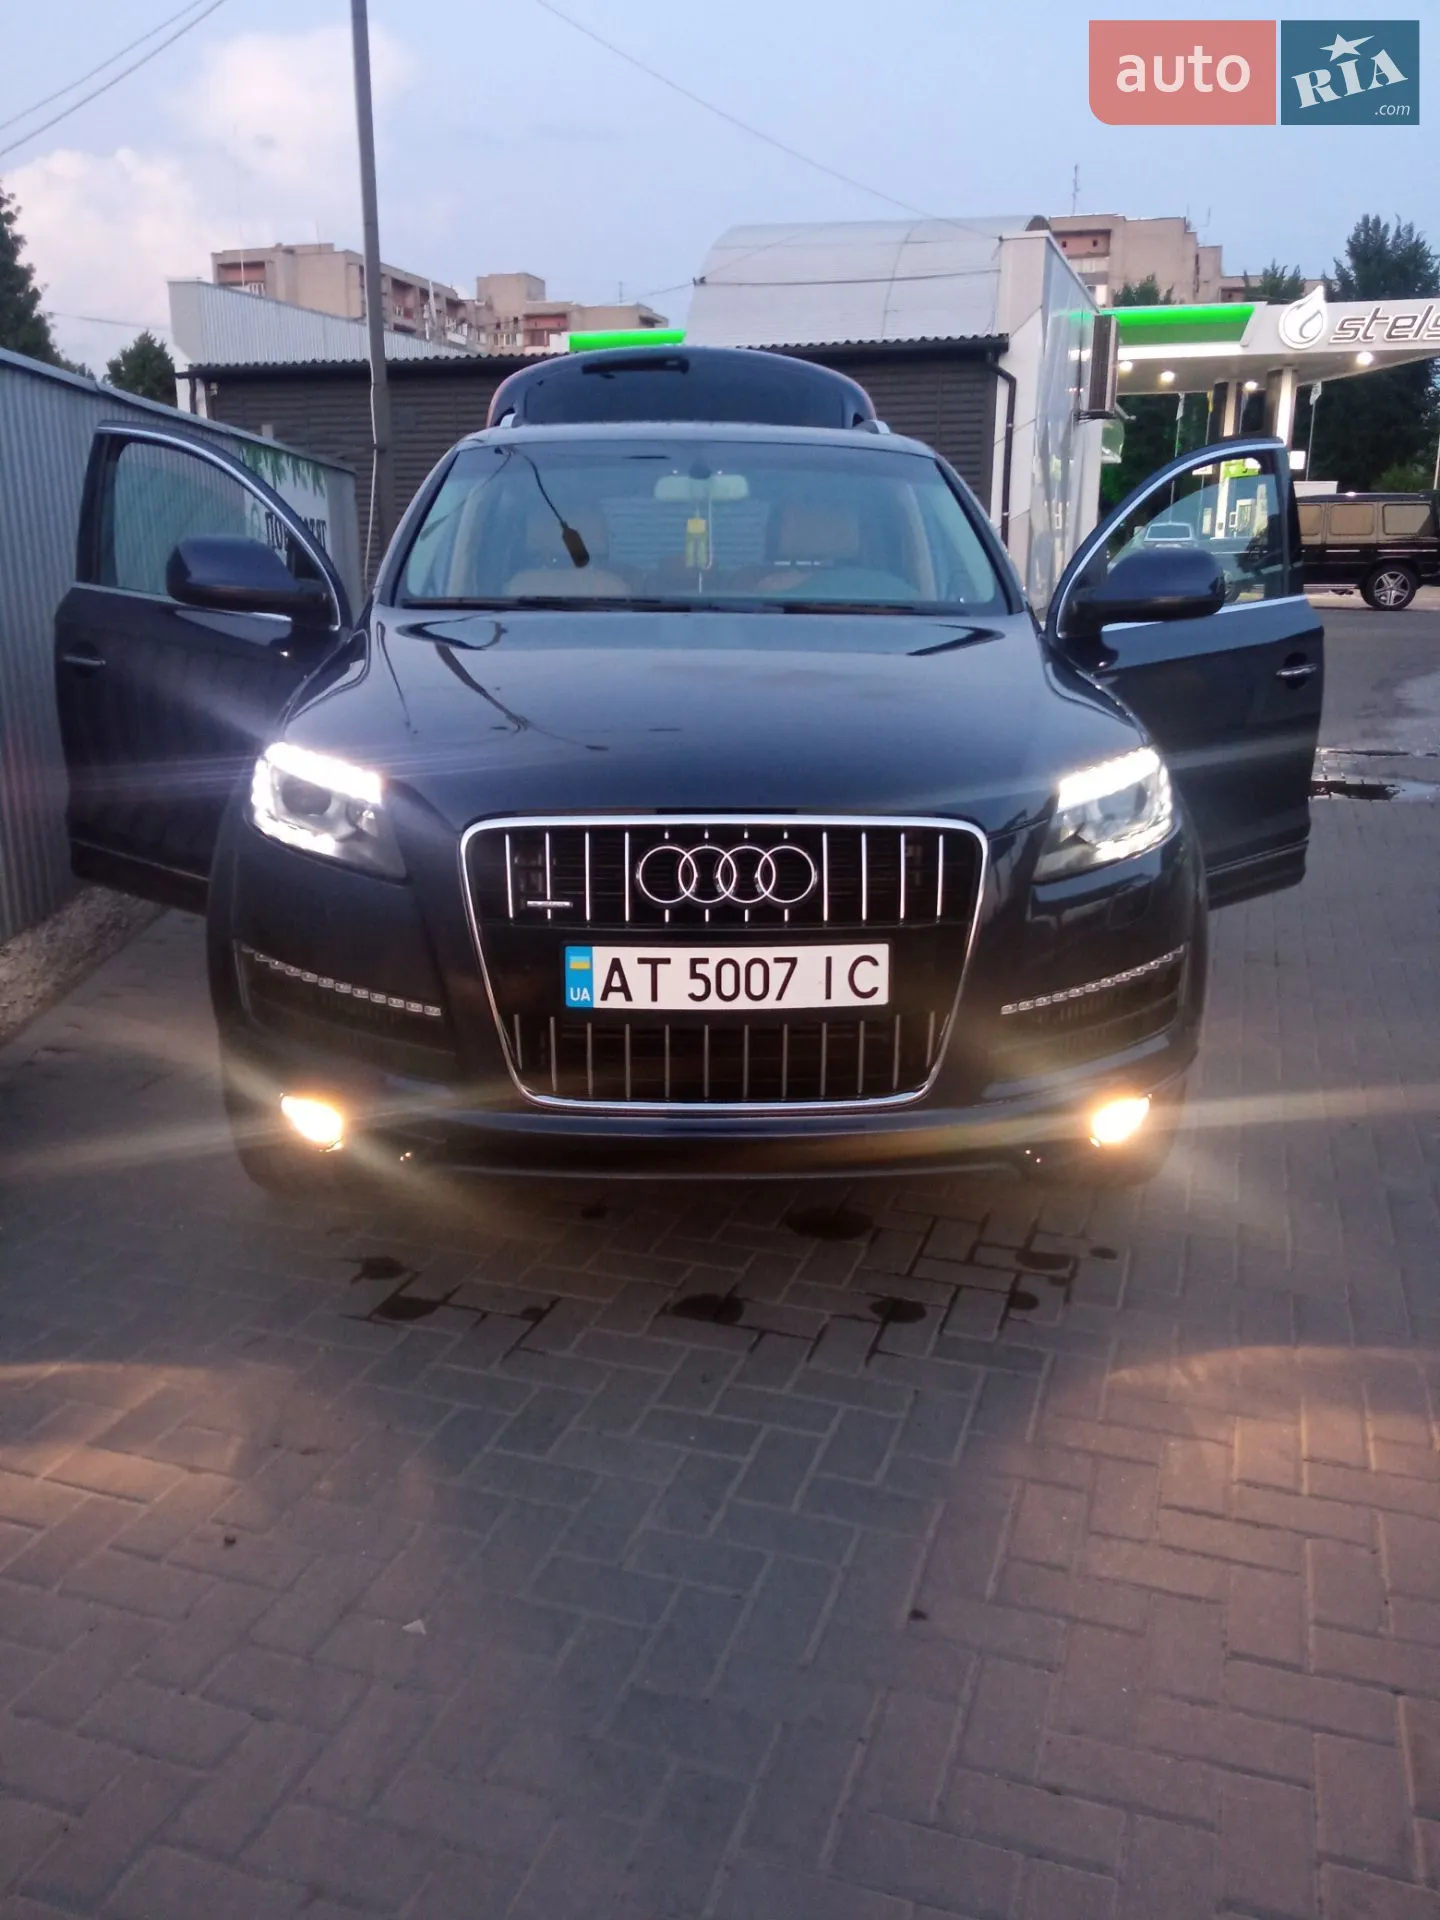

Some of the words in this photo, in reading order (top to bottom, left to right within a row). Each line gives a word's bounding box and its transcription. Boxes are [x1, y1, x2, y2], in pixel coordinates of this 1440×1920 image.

[600, 957, 671, 1002] AT
[687, 956, 798, 1002] 5007
[570, 987, 590, 1002] UA
